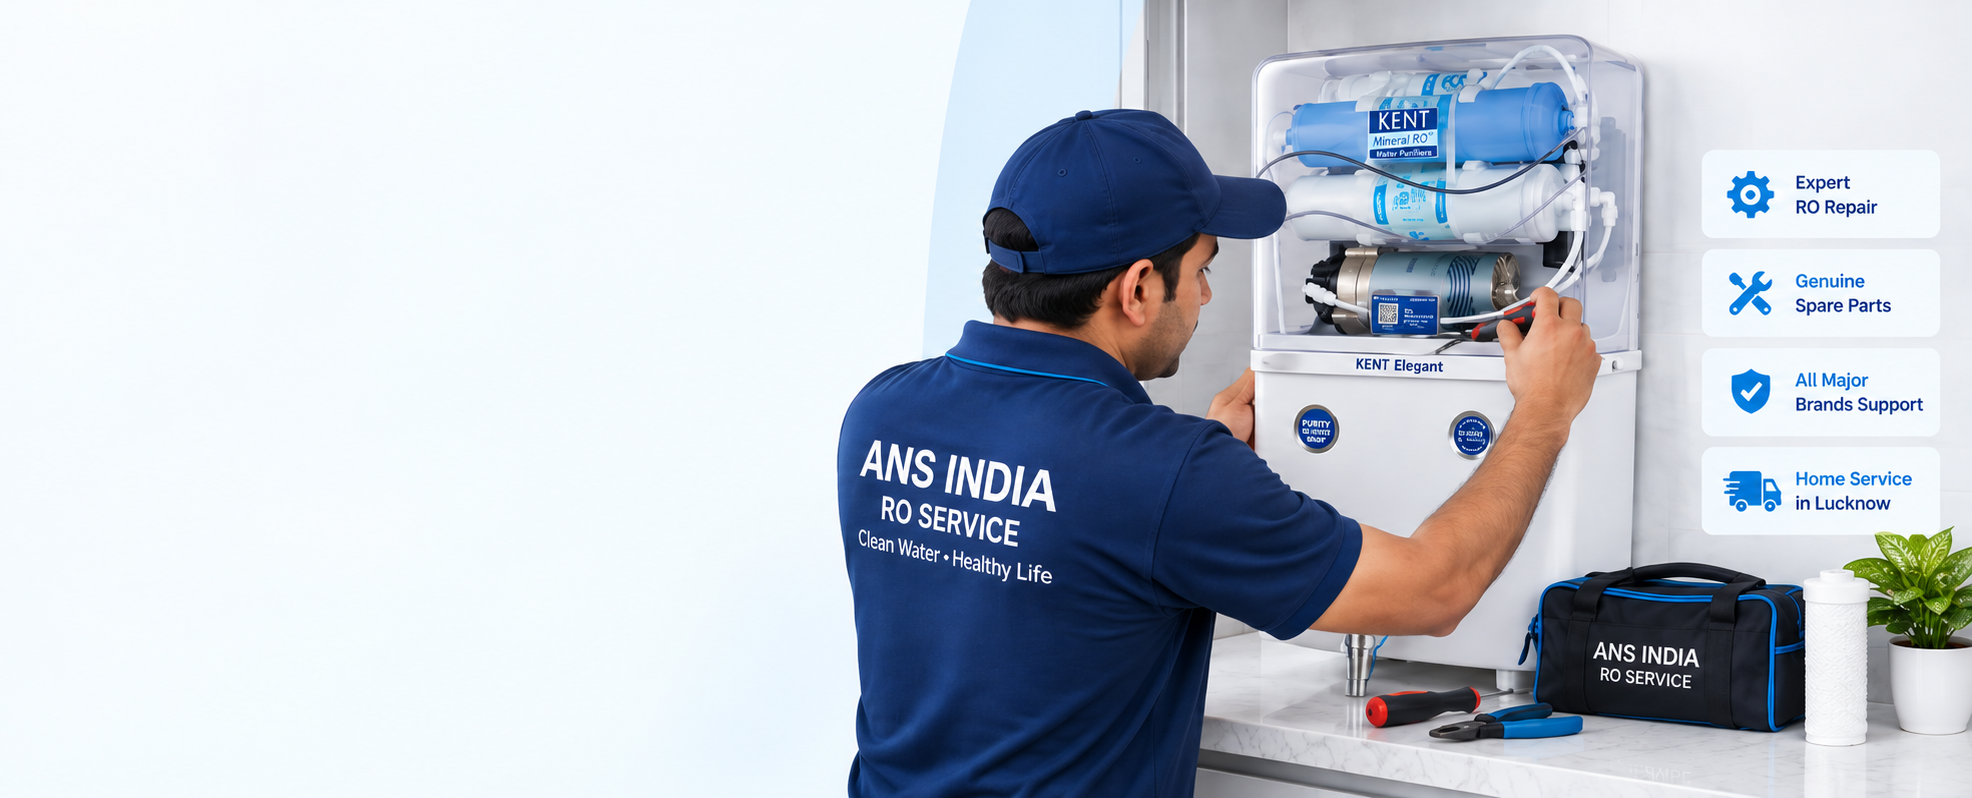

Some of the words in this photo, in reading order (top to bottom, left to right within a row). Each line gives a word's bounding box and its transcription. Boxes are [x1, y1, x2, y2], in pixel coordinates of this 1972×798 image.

[1379, 110, 1430, 130] KENT
[1373, 134, 1410, 147] Mineral
[1356, 358, 1389, 371] KENT
[1395, 359, 1443, 375] Elegant
[860, 440, 936, 489] ANS
[945, 455, 1056, 512] INDIA
[881, 495, 912, 525] RO
[918, 503, 1020, 548] SERVICE
[858, 529, 894, 554] Clean
[897, 537, 940, 563] Water
[952, 549, 1011, 582] Healthy
[1016, 562, 1053, 585] Life
[1593, 641, 1635, 663] ANS
[1642, 645, 1700, 668] INDIA
[1600, 666, 1621, 683] RO
[1625, 669, 1692, 689] SERVICE
